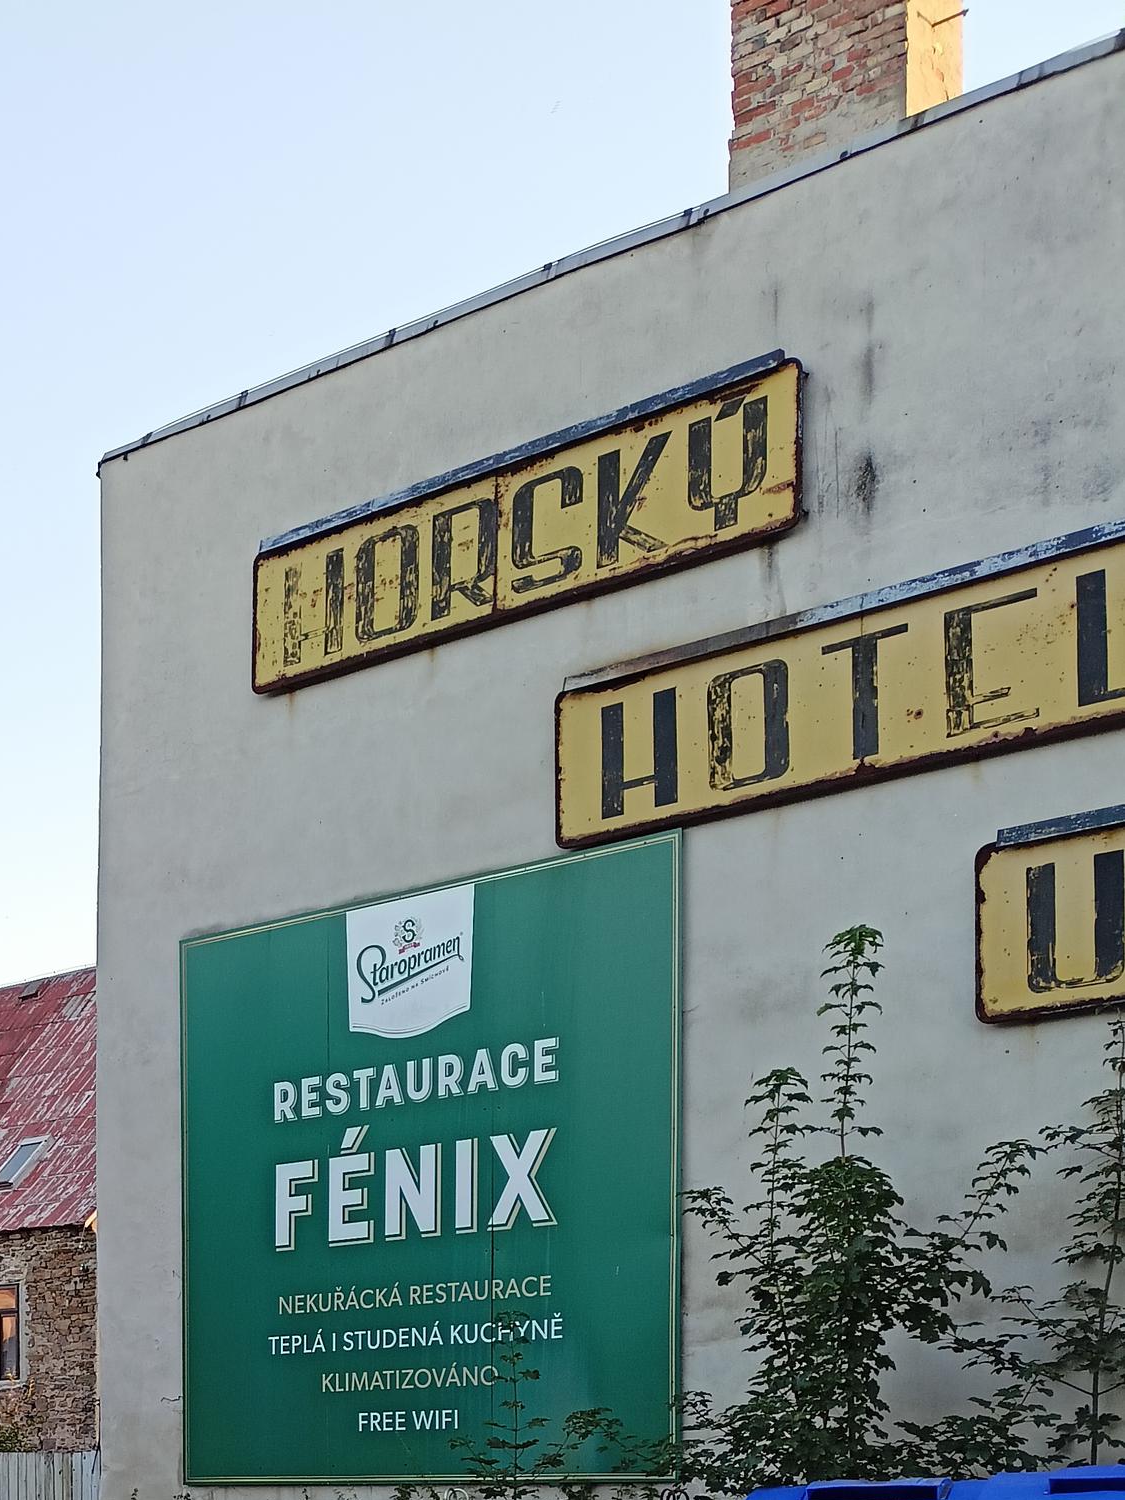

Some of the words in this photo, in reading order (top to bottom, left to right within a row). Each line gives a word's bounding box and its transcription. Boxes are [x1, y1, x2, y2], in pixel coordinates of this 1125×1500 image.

[283, 396, 769, 667] HORSKÝ
[600, 569, 1125, 821] HOTEL
[356, 936, 465, 1003] Staropramen
[274, 1037, 559, 1123] RESTAURACE
[275, 1125, 558, 1252] FÉNIX
[278, 1281, 403, 1315] NEKUŘÁCKÁ
[409, 1275, 552, 1305] RESTAURACE
[268, 1329, 326, 1355] TEPLÁ
[331, 1332, 336, 1352] I
[342, 1321, 444, 1351] STUDENÁ
[450, 1312, 563, 1345] KUCHYNĚ
[321, 1362, 499, 1393] KLIMATIZOVÁNO
[358, 1411, 406, 1432] FREE
[412, 1409, 459, 1430] WIFI
